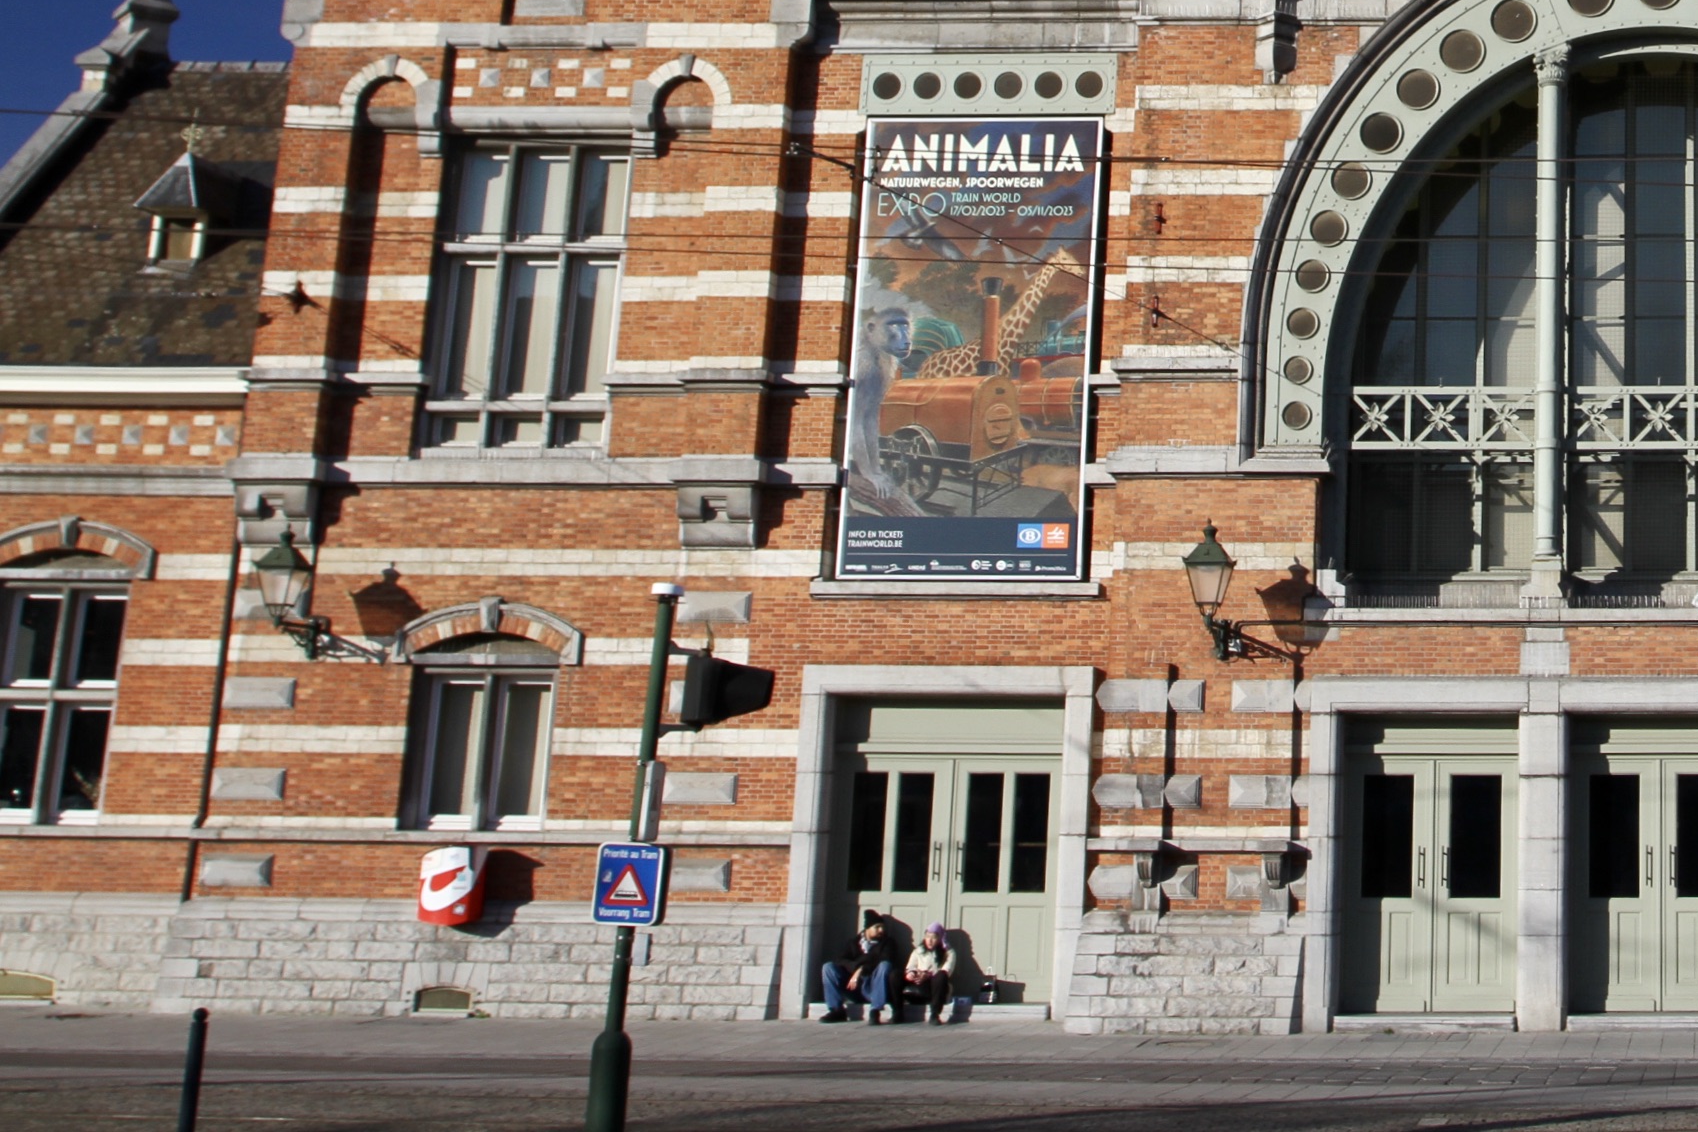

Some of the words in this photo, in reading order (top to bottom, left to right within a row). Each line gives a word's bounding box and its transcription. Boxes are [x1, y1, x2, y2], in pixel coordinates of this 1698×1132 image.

[880, 134, 1086, 172] ANIMALIA
[880, 177, 963, 189] NATUURWEGEN,
[965, 177, 1044, 188] SPOORWEGEN
[951, 192, 980, 203] TRAIN
[982, 192, 1021, 203] WORLD
[877, 192, 948, 217] EXPO
[950, 205, 1005, 217] 17/02/2023
[1016, 205, 1074, 217] 05/11/2023
[848, 530, 867, 539] INFO
[867, 530, 877, 539] EN
[878, 530, 904, 539] TICKETS
[847, 539, 903, 548] TRAINWORLD.BE
[603, 848, 629, 858] Priorité
[630, 851, 639, 859] au
[641, 850, 658, 859] Tram
[599, 908, 630, 920] Voorrang
[633, 908, 650, 917] Tram
